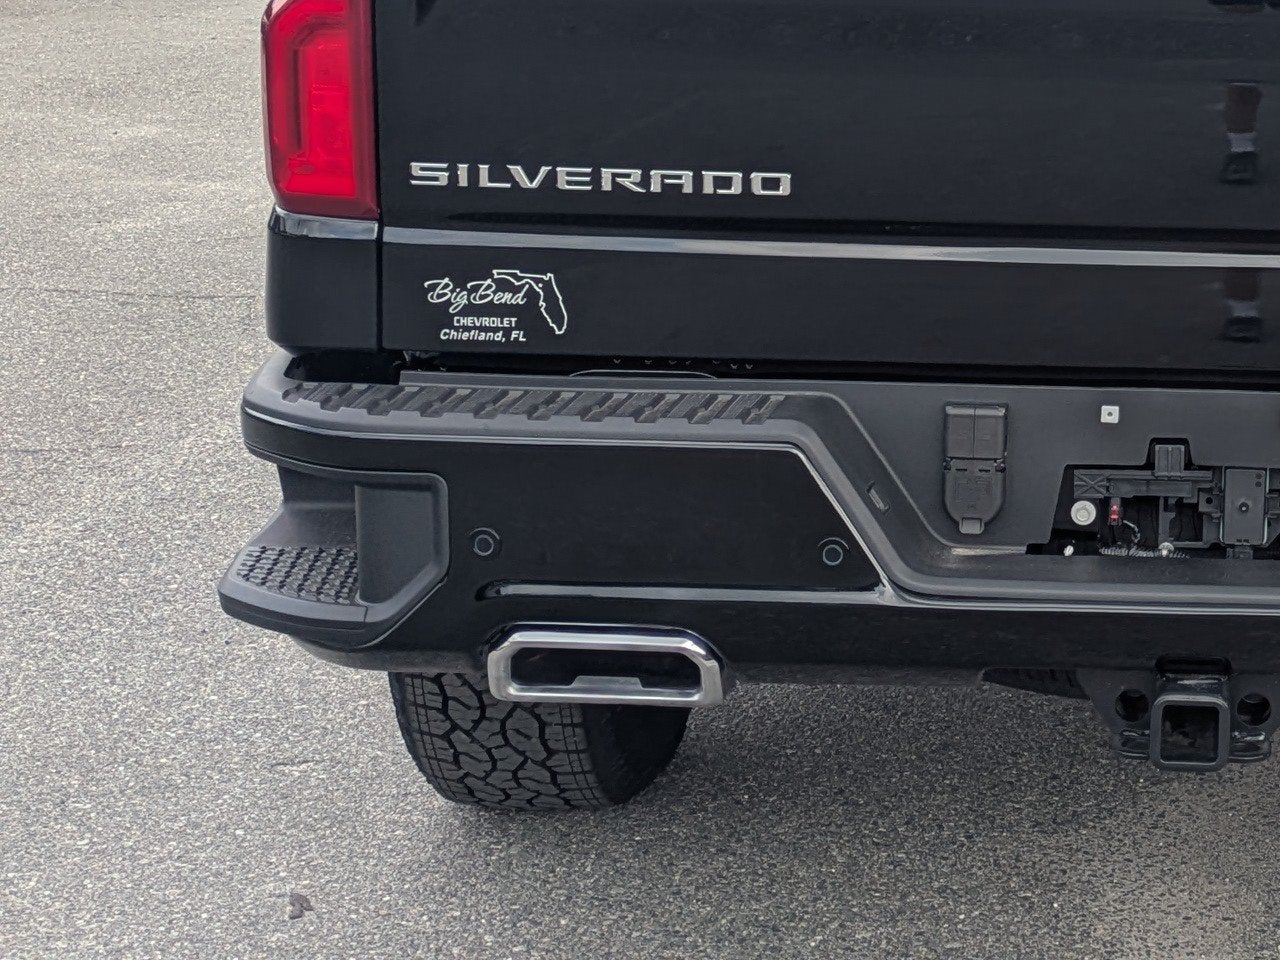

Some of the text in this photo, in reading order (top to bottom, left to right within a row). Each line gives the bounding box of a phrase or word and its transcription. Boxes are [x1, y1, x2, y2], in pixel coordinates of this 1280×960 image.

[409, 161, 792, 196] SILVERADO
[424, 277, 529, 314] Big Bend
[453, 316, 518, 328] CHEVROLET
[440, 329, 527, 343] Chiefland, FL
